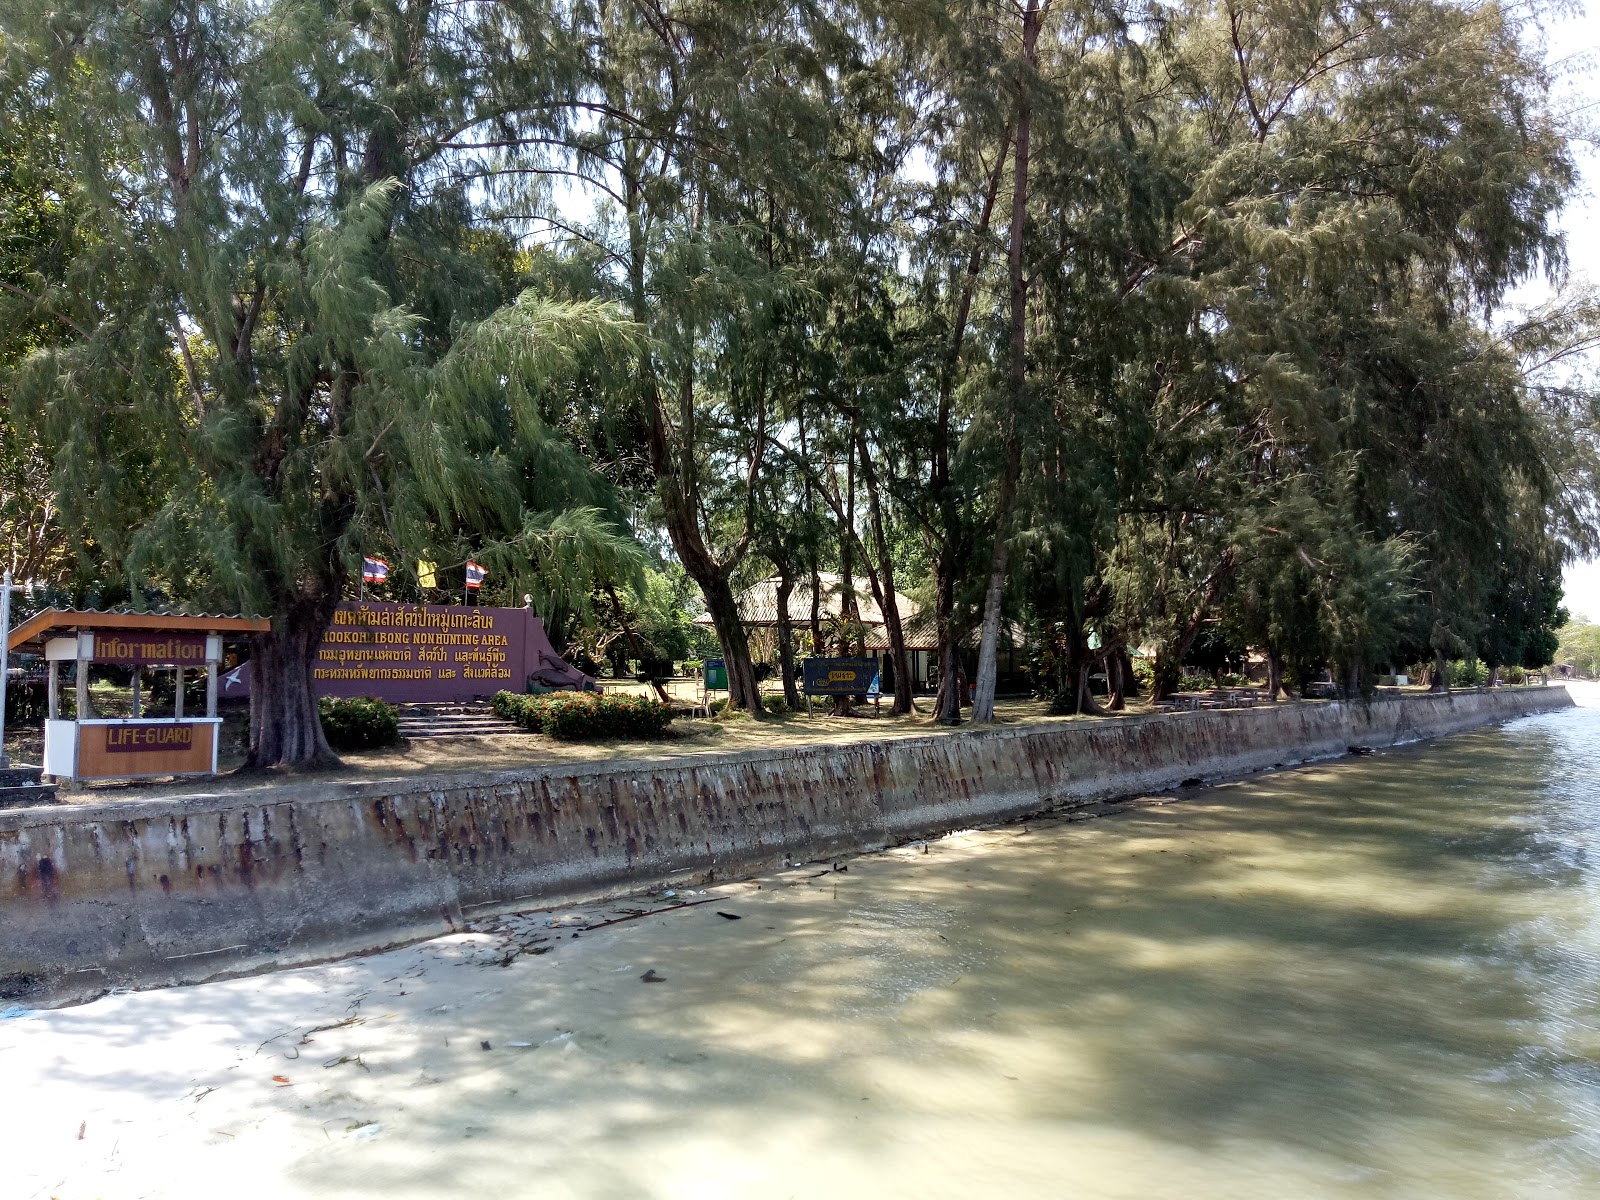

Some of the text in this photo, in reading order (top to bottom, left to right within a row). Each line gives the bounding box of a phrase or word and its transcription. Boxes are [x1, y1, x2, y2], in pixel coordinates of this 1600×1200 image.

[95, 636, 204, 659] Information
[481, 635, 508, 646] AREA
[418, 646, 447, 662] สัตว์ป่า
[438, 669, 456, 679] และ
[463, 662, 511, 679] สิ่งแวดล้อม
[108, 727, 192, 745] LIFE-GUARD
